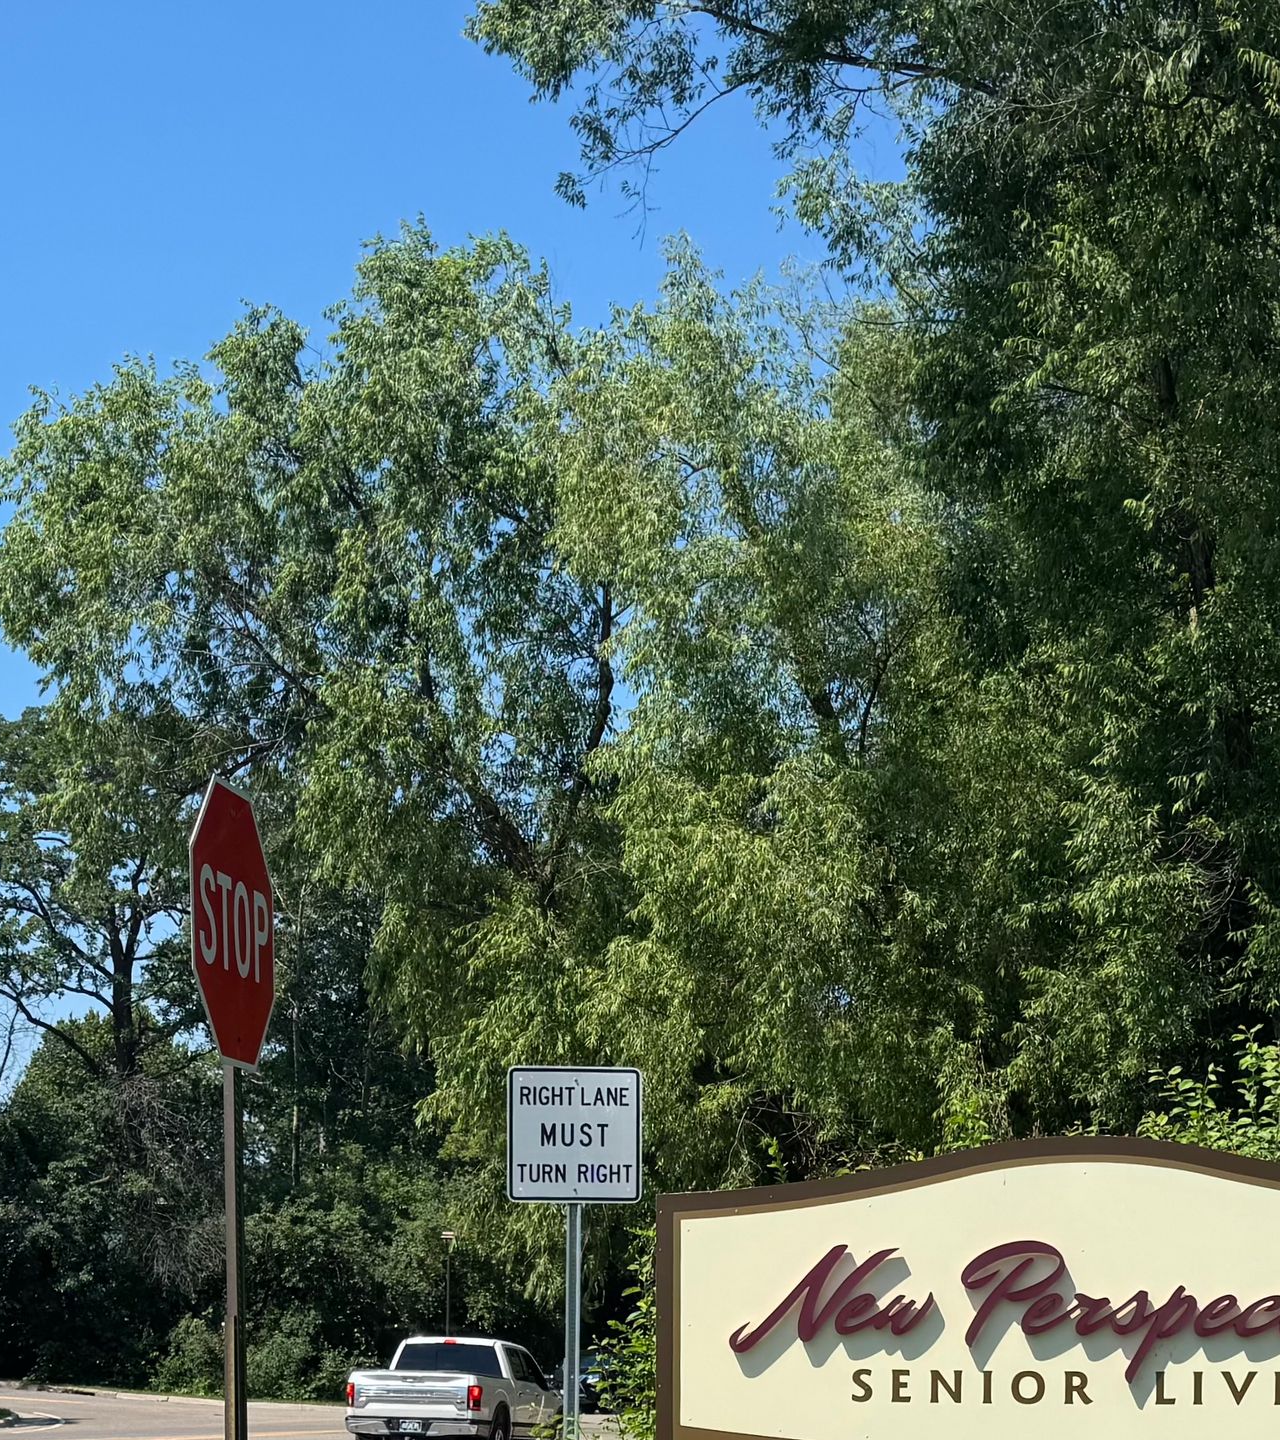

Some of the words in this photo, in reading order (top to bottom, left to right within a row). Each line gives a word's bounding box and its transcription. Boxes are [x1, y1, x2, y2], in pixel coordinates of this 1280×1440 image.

[199, 863, 269, 984] STOP
[519, 1086, 576, 1107] RIGHT
[580, 1086, 630, 1107] LANE
[540, 1122, 609, 1148] MUST
[516, 1163, 567, 1184] TURN
[577, 1163, 633, 1184] RIGHT
[730, 1244, 934, 1353] New
[851, 1368, 1094, 1406] SENIOR
